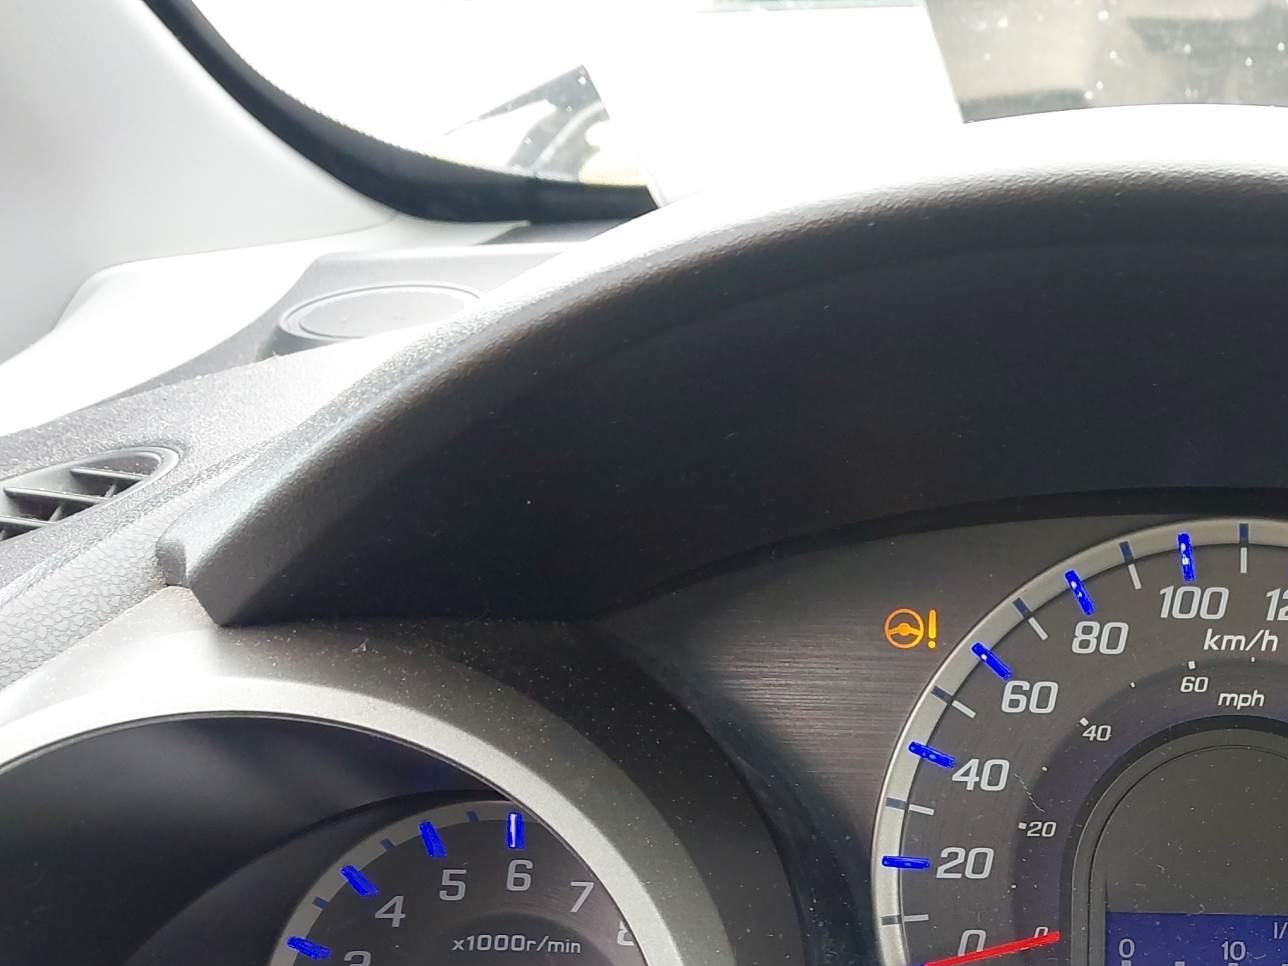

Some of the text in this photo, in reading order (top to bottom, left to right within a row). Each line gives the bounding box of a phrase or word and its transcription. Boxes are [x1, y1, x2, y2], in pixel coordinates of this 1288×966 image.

[1159, 586, 1229, 620] 100
[1071, 621, 1129, 655] 80
[1203, 629, 1279, 653] km/h
[1001, 680, 1058, 714] 60
[1179, 676, 1209, 694] 60
[1217, 689, 1265, 710] mph
[1082, 723, 1112, 742] 40
[951, 759, 1008, 791] 40
[1025, 821, 1056, 838] 20
[506, 860, 534, 891] 6
[935, 847, 994, 880] 20
[440, 869, 467, 901] 5
[570, 882, 594, 913] 7
[375, 896, 406, 928] 4
[452, 935, 581, 954] x1000r/min
[1118, 941, 1135, 960] 0
[1222, 941, 1246, 960] 10
